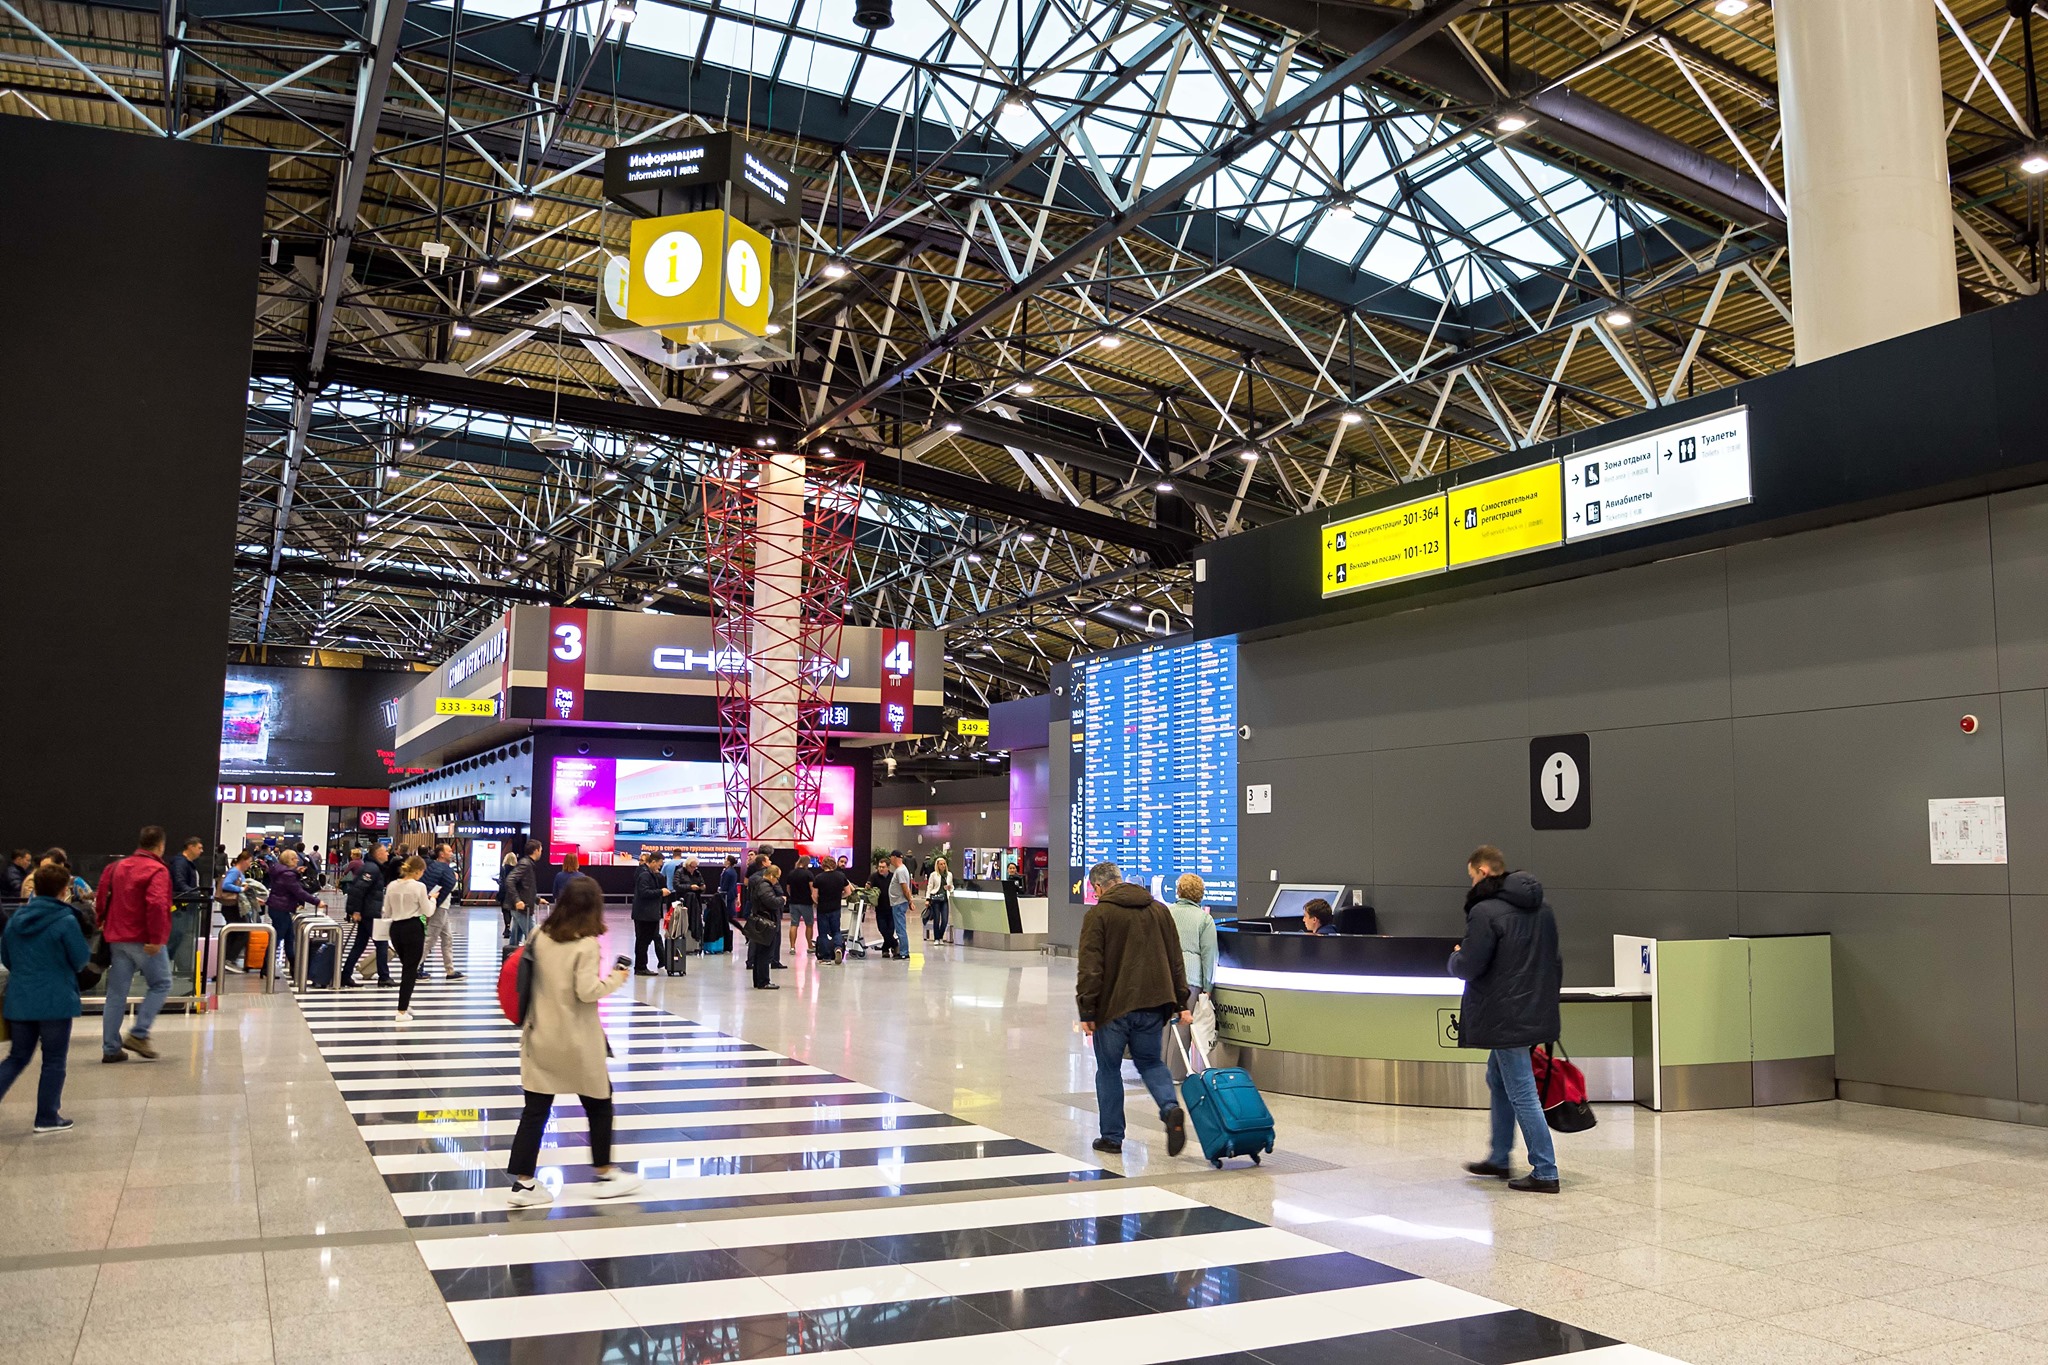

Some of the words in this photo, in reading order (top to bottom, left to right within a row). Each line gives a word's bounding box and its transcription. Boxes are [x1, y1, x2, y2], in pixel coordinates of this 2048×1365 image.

[629, 148, 704, 168] Информация
[628, 168, 671, 181] Information
[1701, 429, 1737, 445] Туалеты
[1604, 459, 1622, 471] Зона
[1623, 452, 1651, 466] отдыха
[1480, 491, 1539, 513] Самостоятельная
[1605, 491, 1653, 509] Авиабилеты
[1403, 506, 1439, 527] 301-364
[1481, 508, 1523, 525] регистрация
[1379, 552, 1402, 566] посадку
[1404, 540, 1439, 560] 101-123
[554, 625, 582, 661] 3
[884, 641, 913, 675] 4
[440, 702, 461, 713] 333
[470, 703, 491, 713] 348
[961, 723, 978, 732] 349
[251, 788, 313, 803] 101-123
[1249, 789, 1254, 801] 3
[458, 826, 494, 834] wrapping
